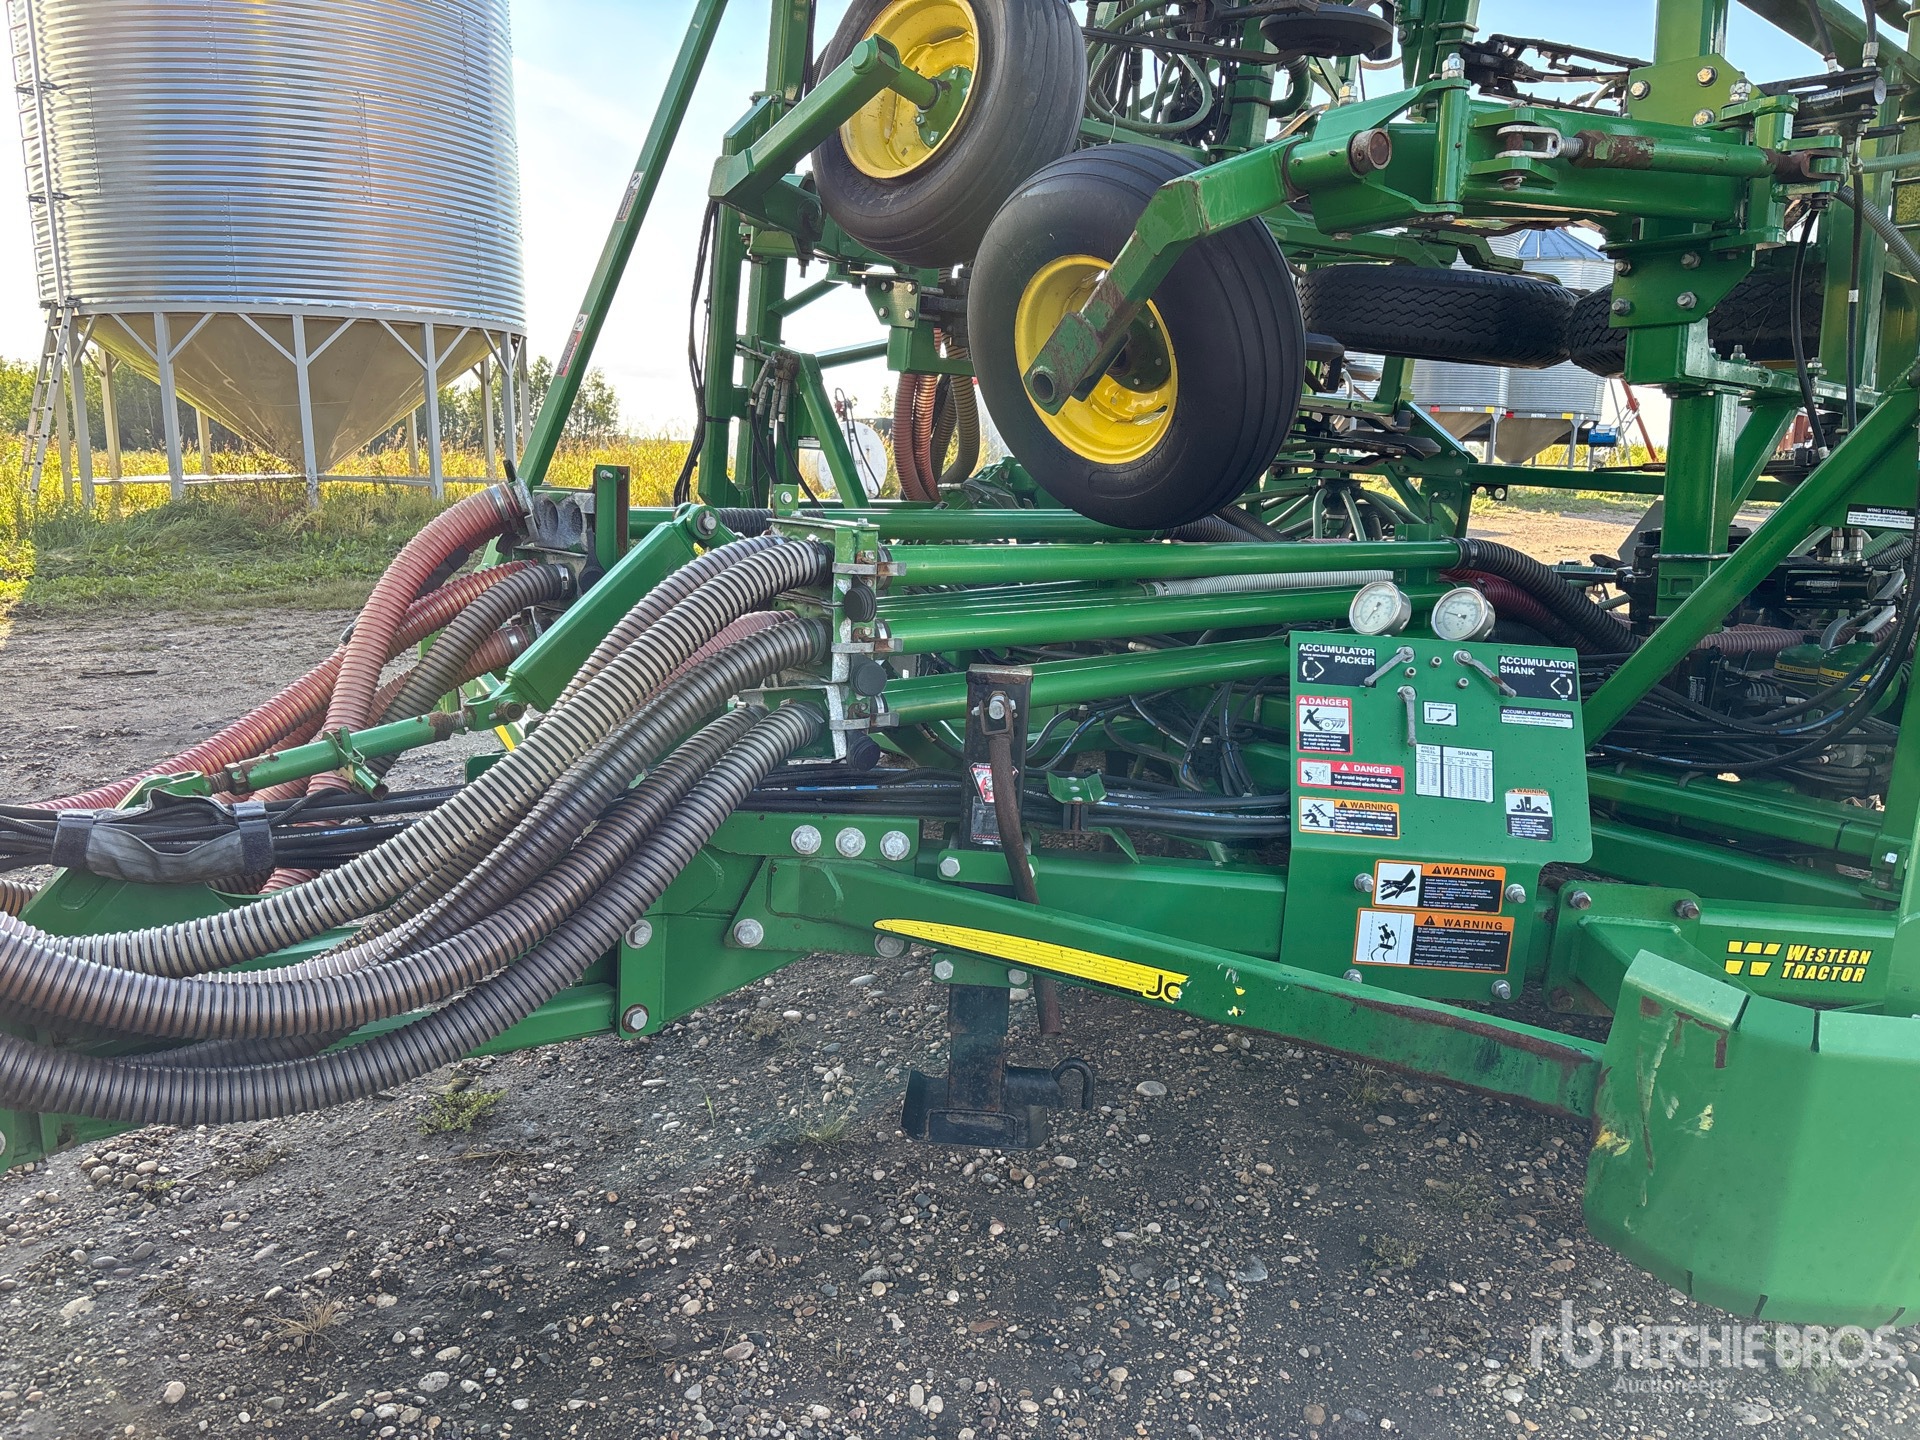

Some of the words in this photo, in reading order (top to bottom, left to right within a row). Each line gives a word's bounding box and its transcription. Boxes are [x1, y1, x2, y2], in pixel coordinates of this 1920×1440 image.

[1299, 644, 1375, 656] ACCUMULATOR
[1334, 656, 1375, 666] PACKER
[1500, 656, 1575, 669] ACCUMULATOR
[1500, 666, 1535, 676] SHANK
[1308, 698, 1348, 706] DANGER
[1354, 764, 1392, 774] DANGER
[1350, 802, 1393, 811] WARNING
[1442, 867, 1495, 877] WARNING
[1444, 918, 1503, 930] WARNING
[1786, 944, 1872, 964] WESTERN
[1781, 962, 1866, 982] TRACTOR
